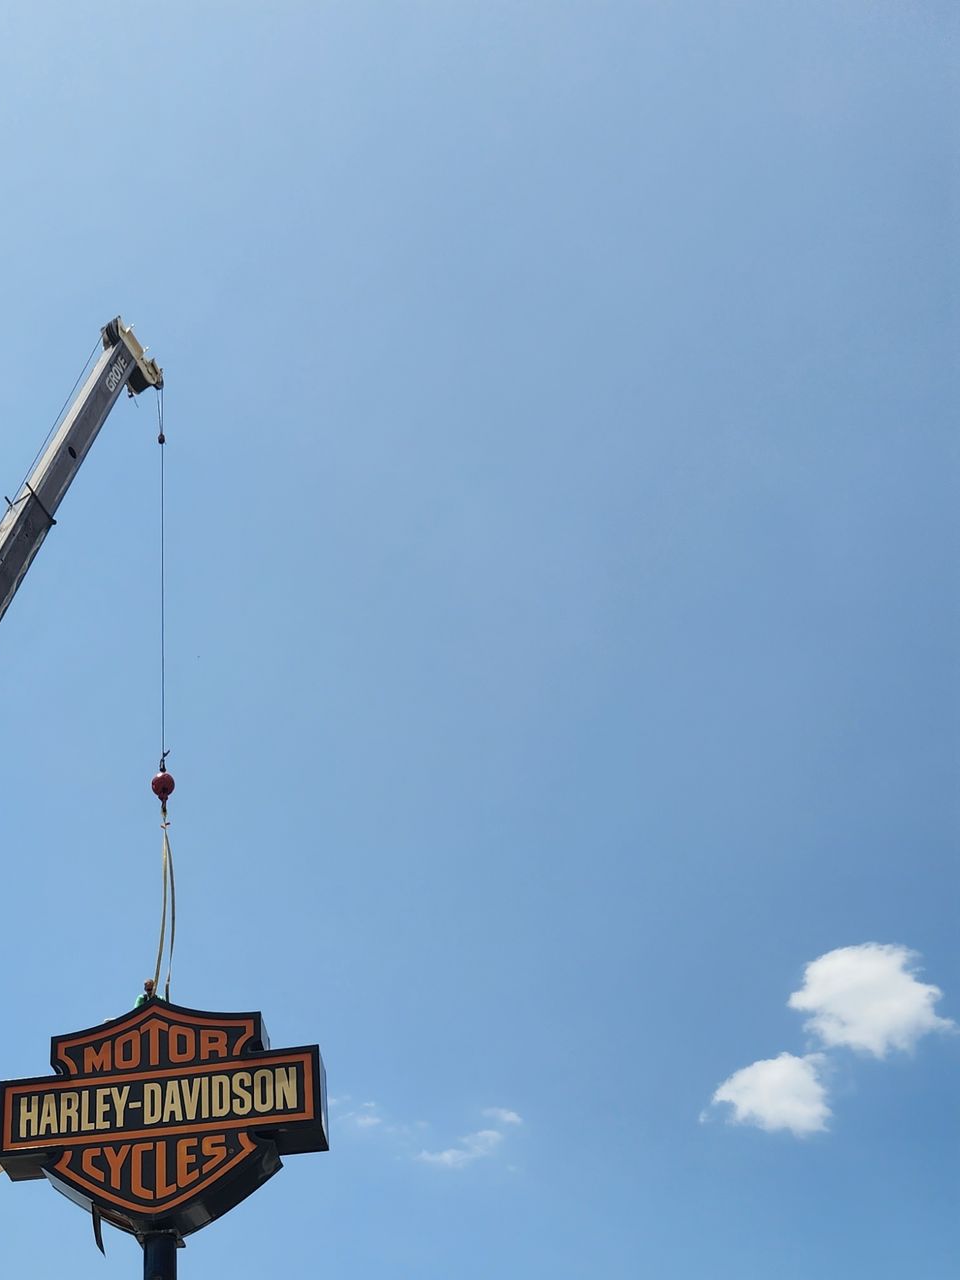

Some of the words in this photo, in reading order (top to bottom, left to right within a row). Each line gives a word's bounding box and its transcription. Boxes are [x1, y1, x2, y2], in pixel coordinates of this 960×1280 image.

[105, 356, 128, 393] GROVE
[83, 1018, 229, 1074] MOTOR
[18, 1066, 298, 1139] HARLEY-DAVIDSON
[82, 1134, 228, 1200] CYCLES
